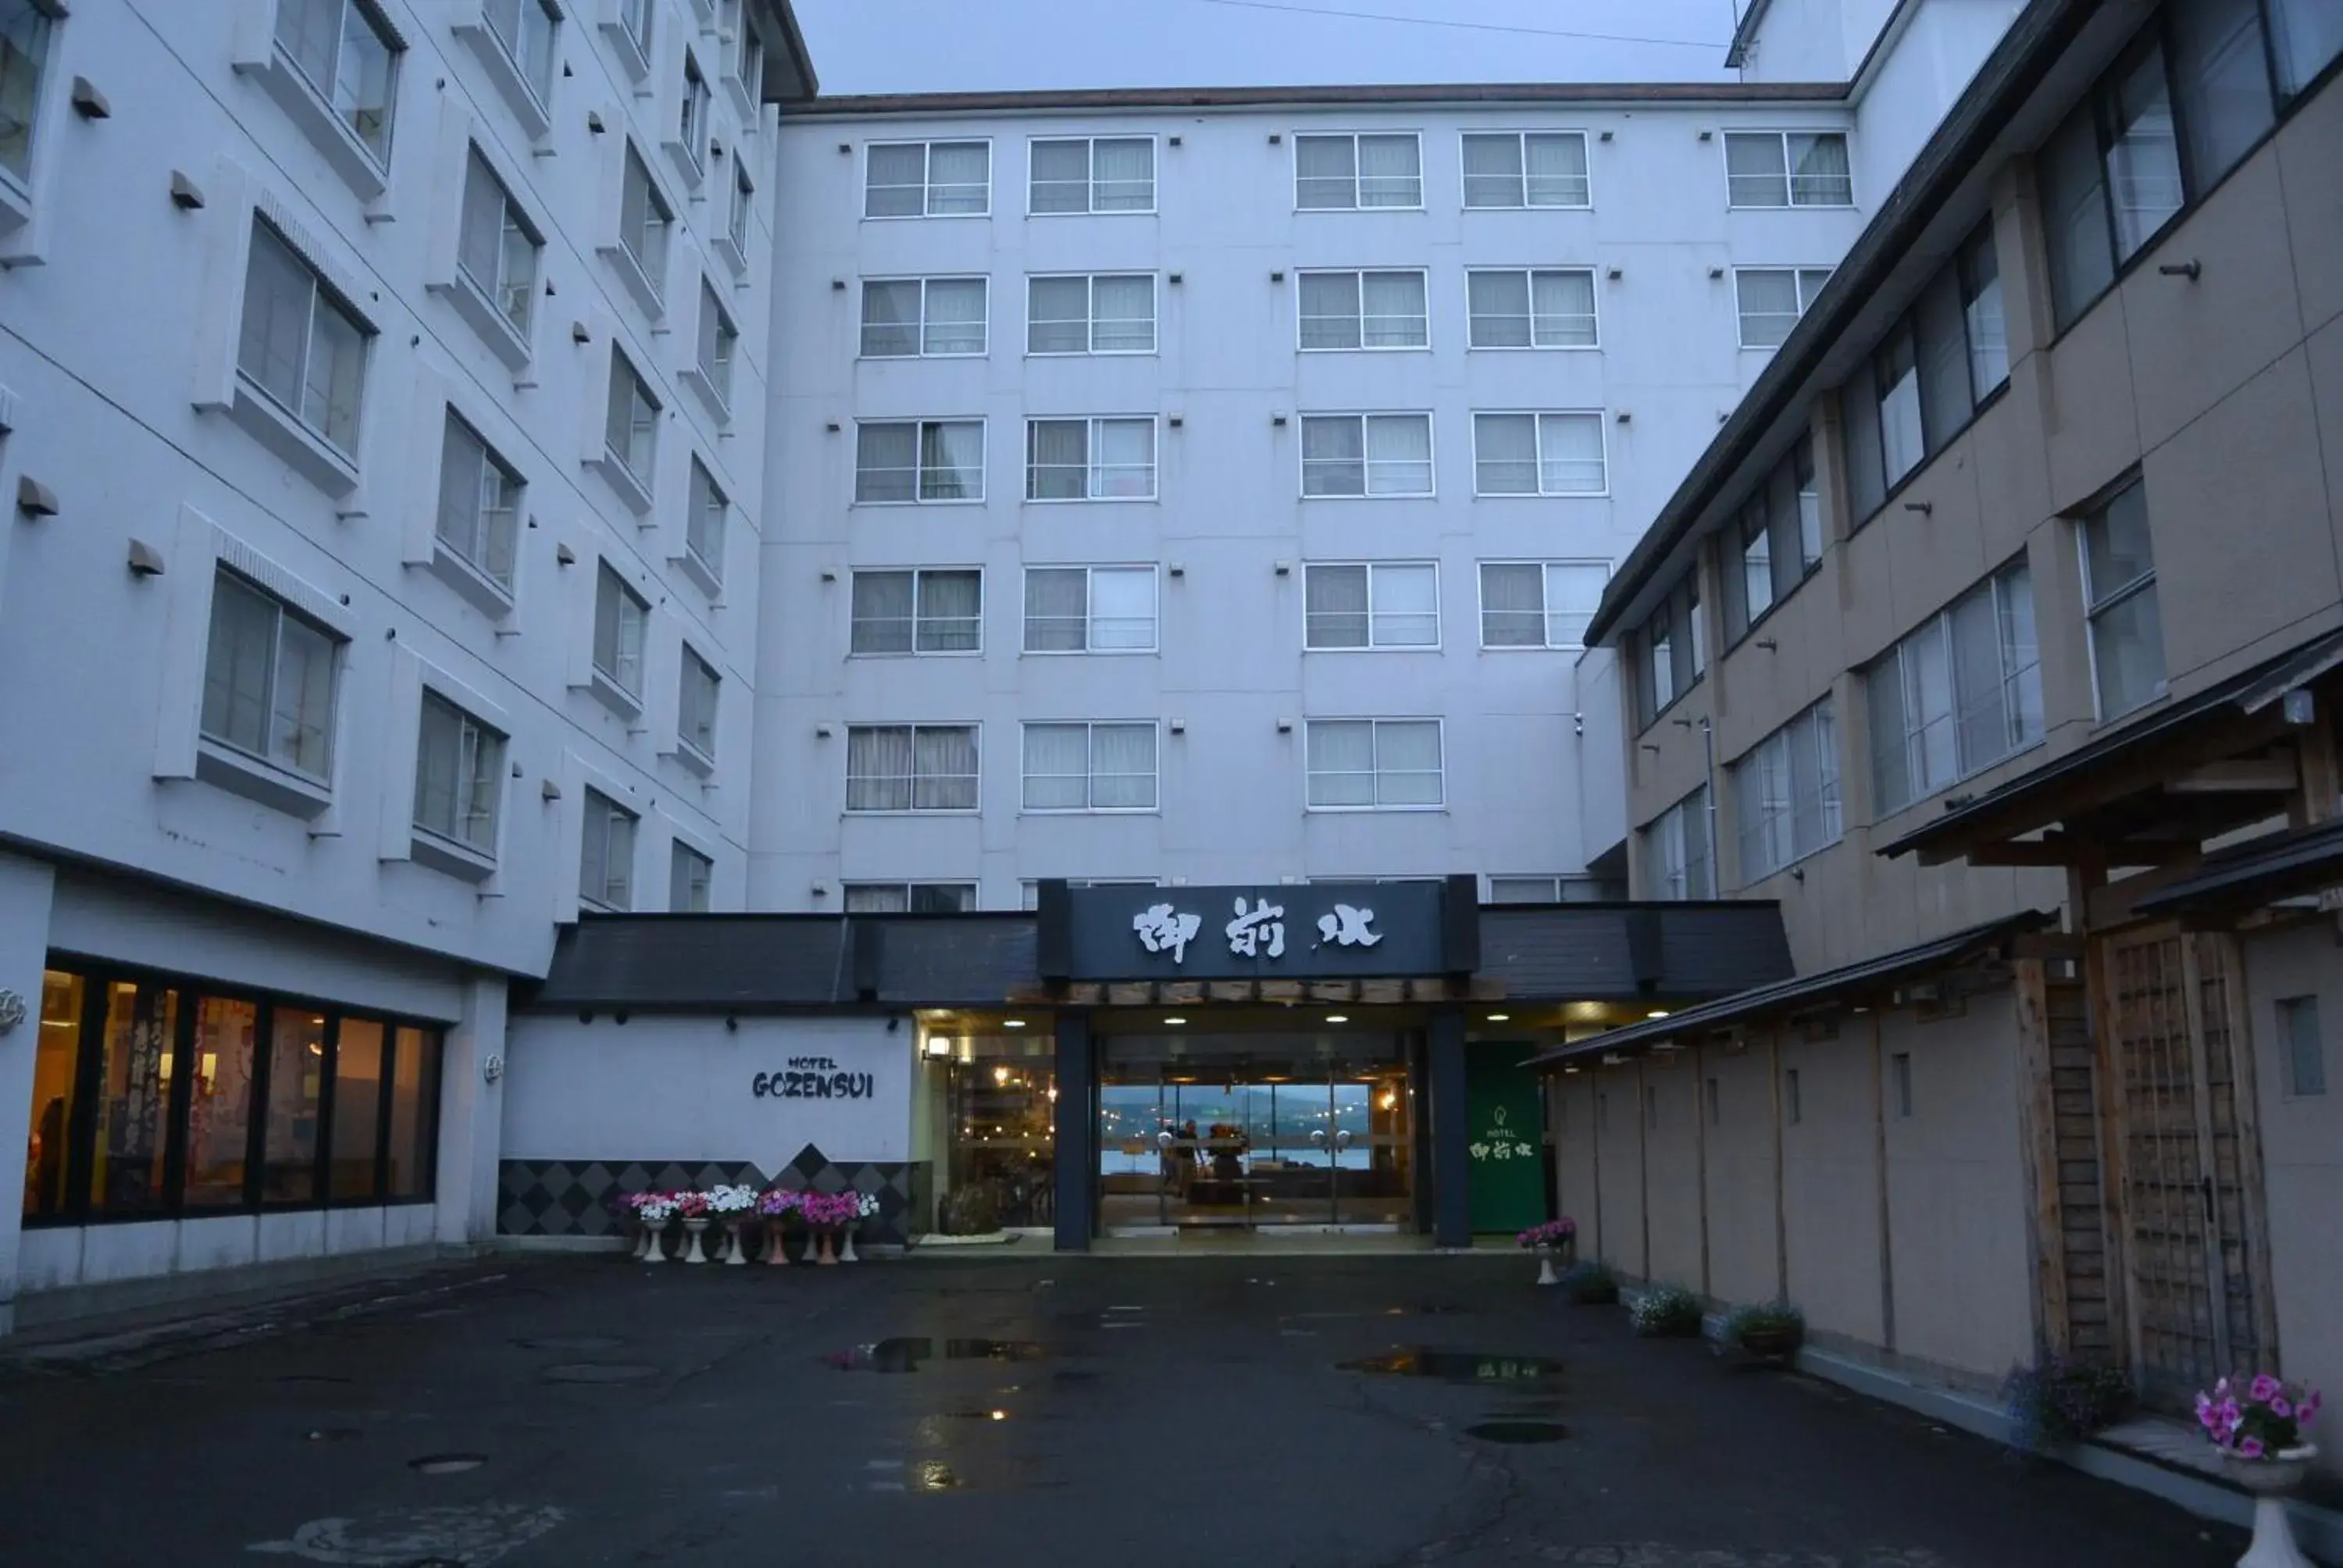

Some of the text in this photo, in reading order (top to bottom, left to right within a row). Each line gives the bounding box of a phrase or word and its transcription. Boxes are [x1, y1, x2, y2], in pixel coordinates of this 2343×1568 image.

[1133, 896, 1384, 964] 御前水
[788, 1057, 837, 1070] HOTEL
[752, 1072, 874, 1099] GOZENSUI
